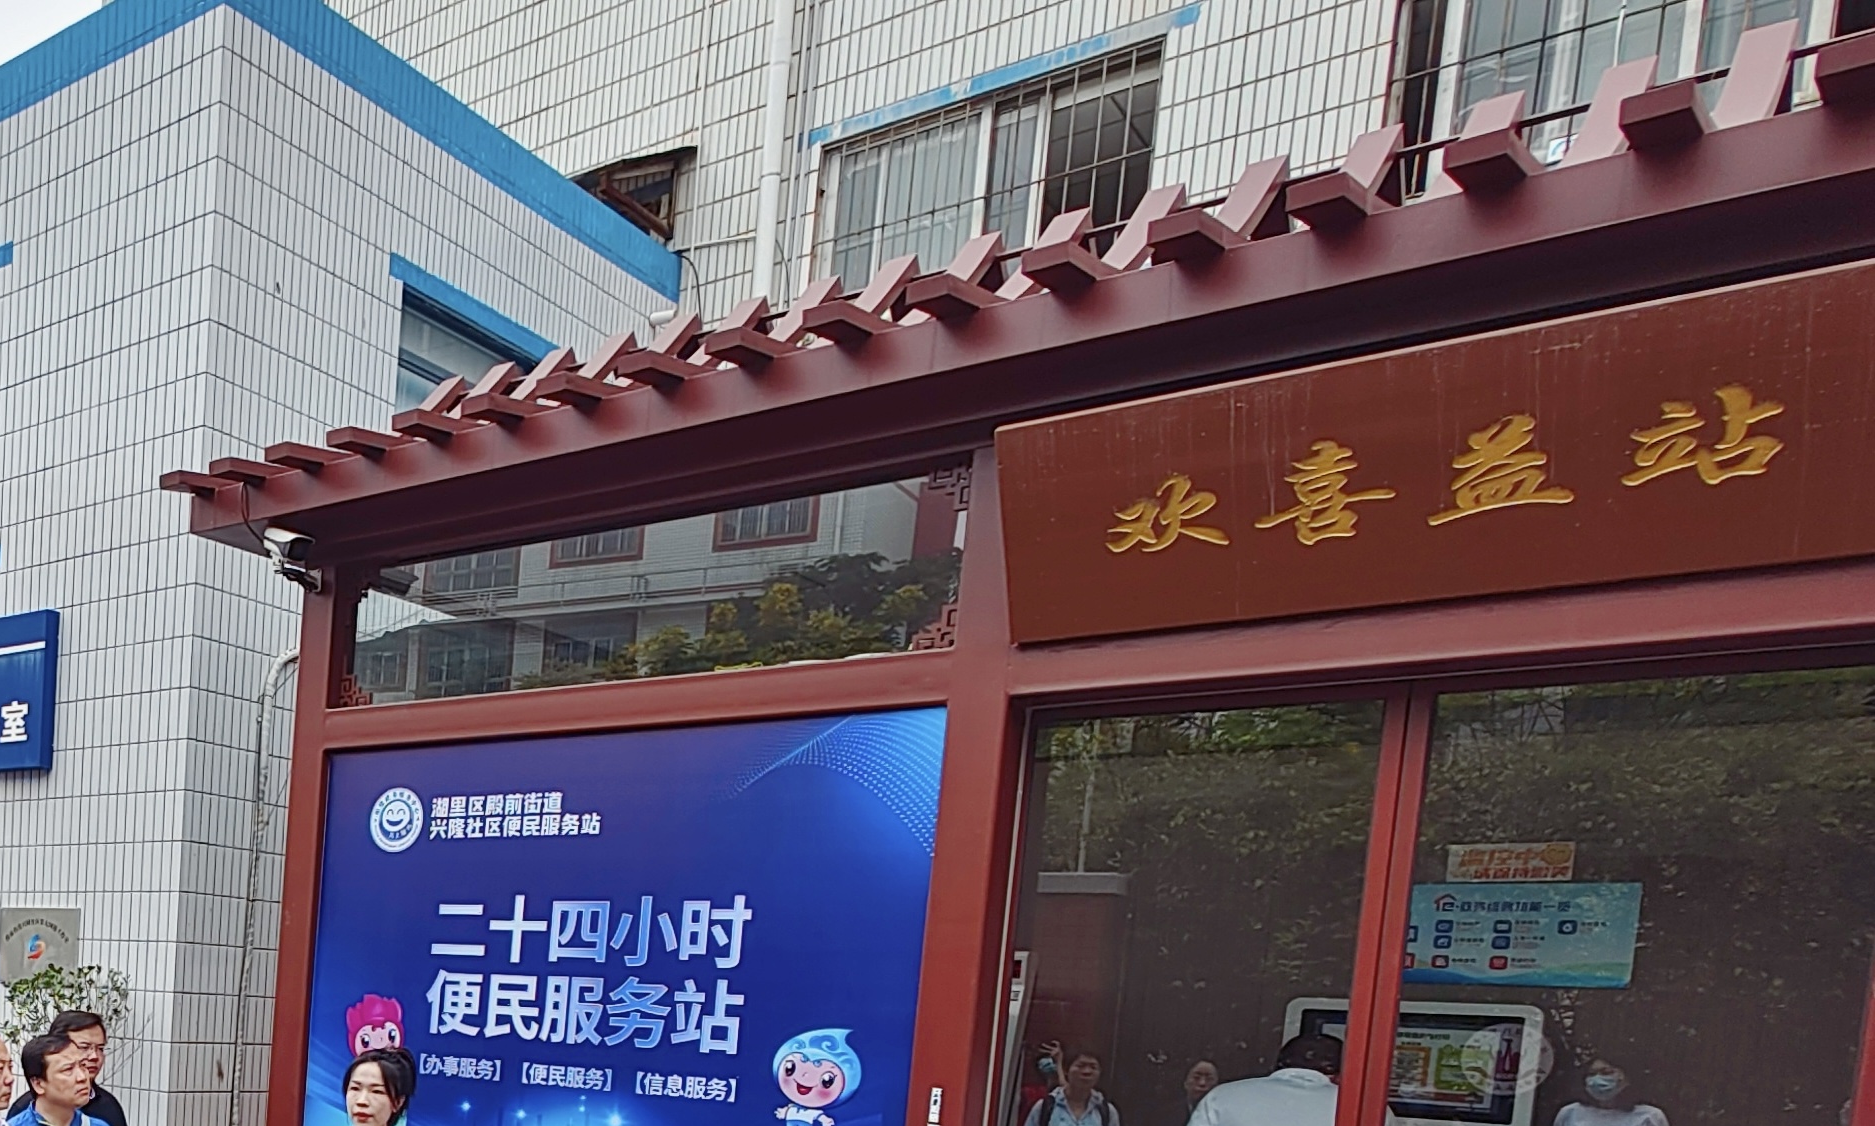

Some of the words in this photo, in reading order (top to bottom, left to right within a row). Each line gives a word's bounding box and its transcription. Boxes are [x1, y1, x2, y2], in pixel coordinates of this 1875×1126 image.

[1104, 384, 1786, 555] 欢喜益站
[428, 812, 602, 840] 兴隆社区便民服务站
[430, 791, 564, 818] 湖里区殿前街道
[430, 894, 753, 969] 二十四小时
[426, 968, 745, 1055] 便民服务站
[419, 1053, 501, 1081] 【办事服务】
[521, 1062, 613, 1092] 【便民服务】
[634, 1071, 737, 1103] 【信息服务】
